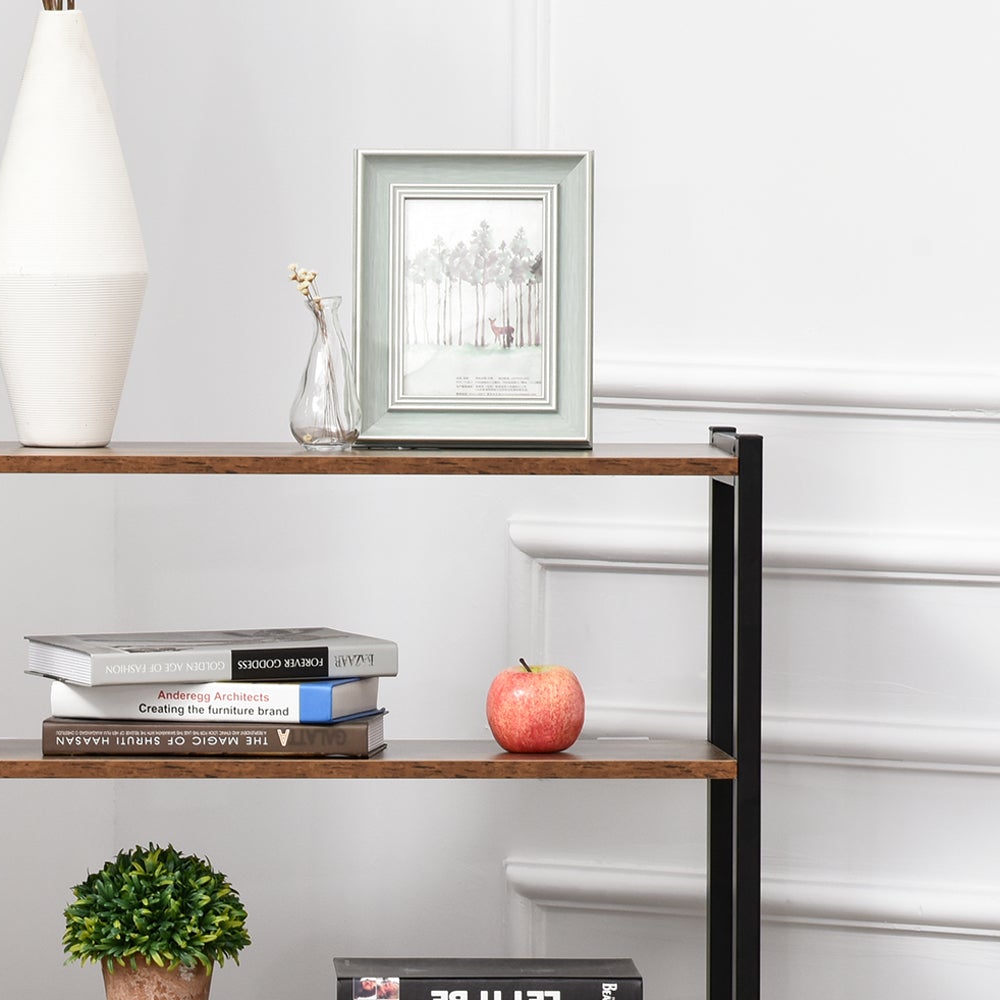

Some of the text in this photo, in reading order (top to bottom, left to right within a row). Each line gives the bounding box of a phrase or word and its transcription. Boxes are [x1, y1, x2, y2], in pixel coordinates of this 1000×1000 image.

[105, 661, 225, 675] GOLDEN AGE OF FASHION
[237, 656, 324, 670] FOREVER GODDESS
[157, 690, 270, 703] Anderegg Architects
[138, 703, 290, 717] Creating the furniture brand
[56, 736, 268, 746] THE MAGIC OF SHRUTI HAASAN
